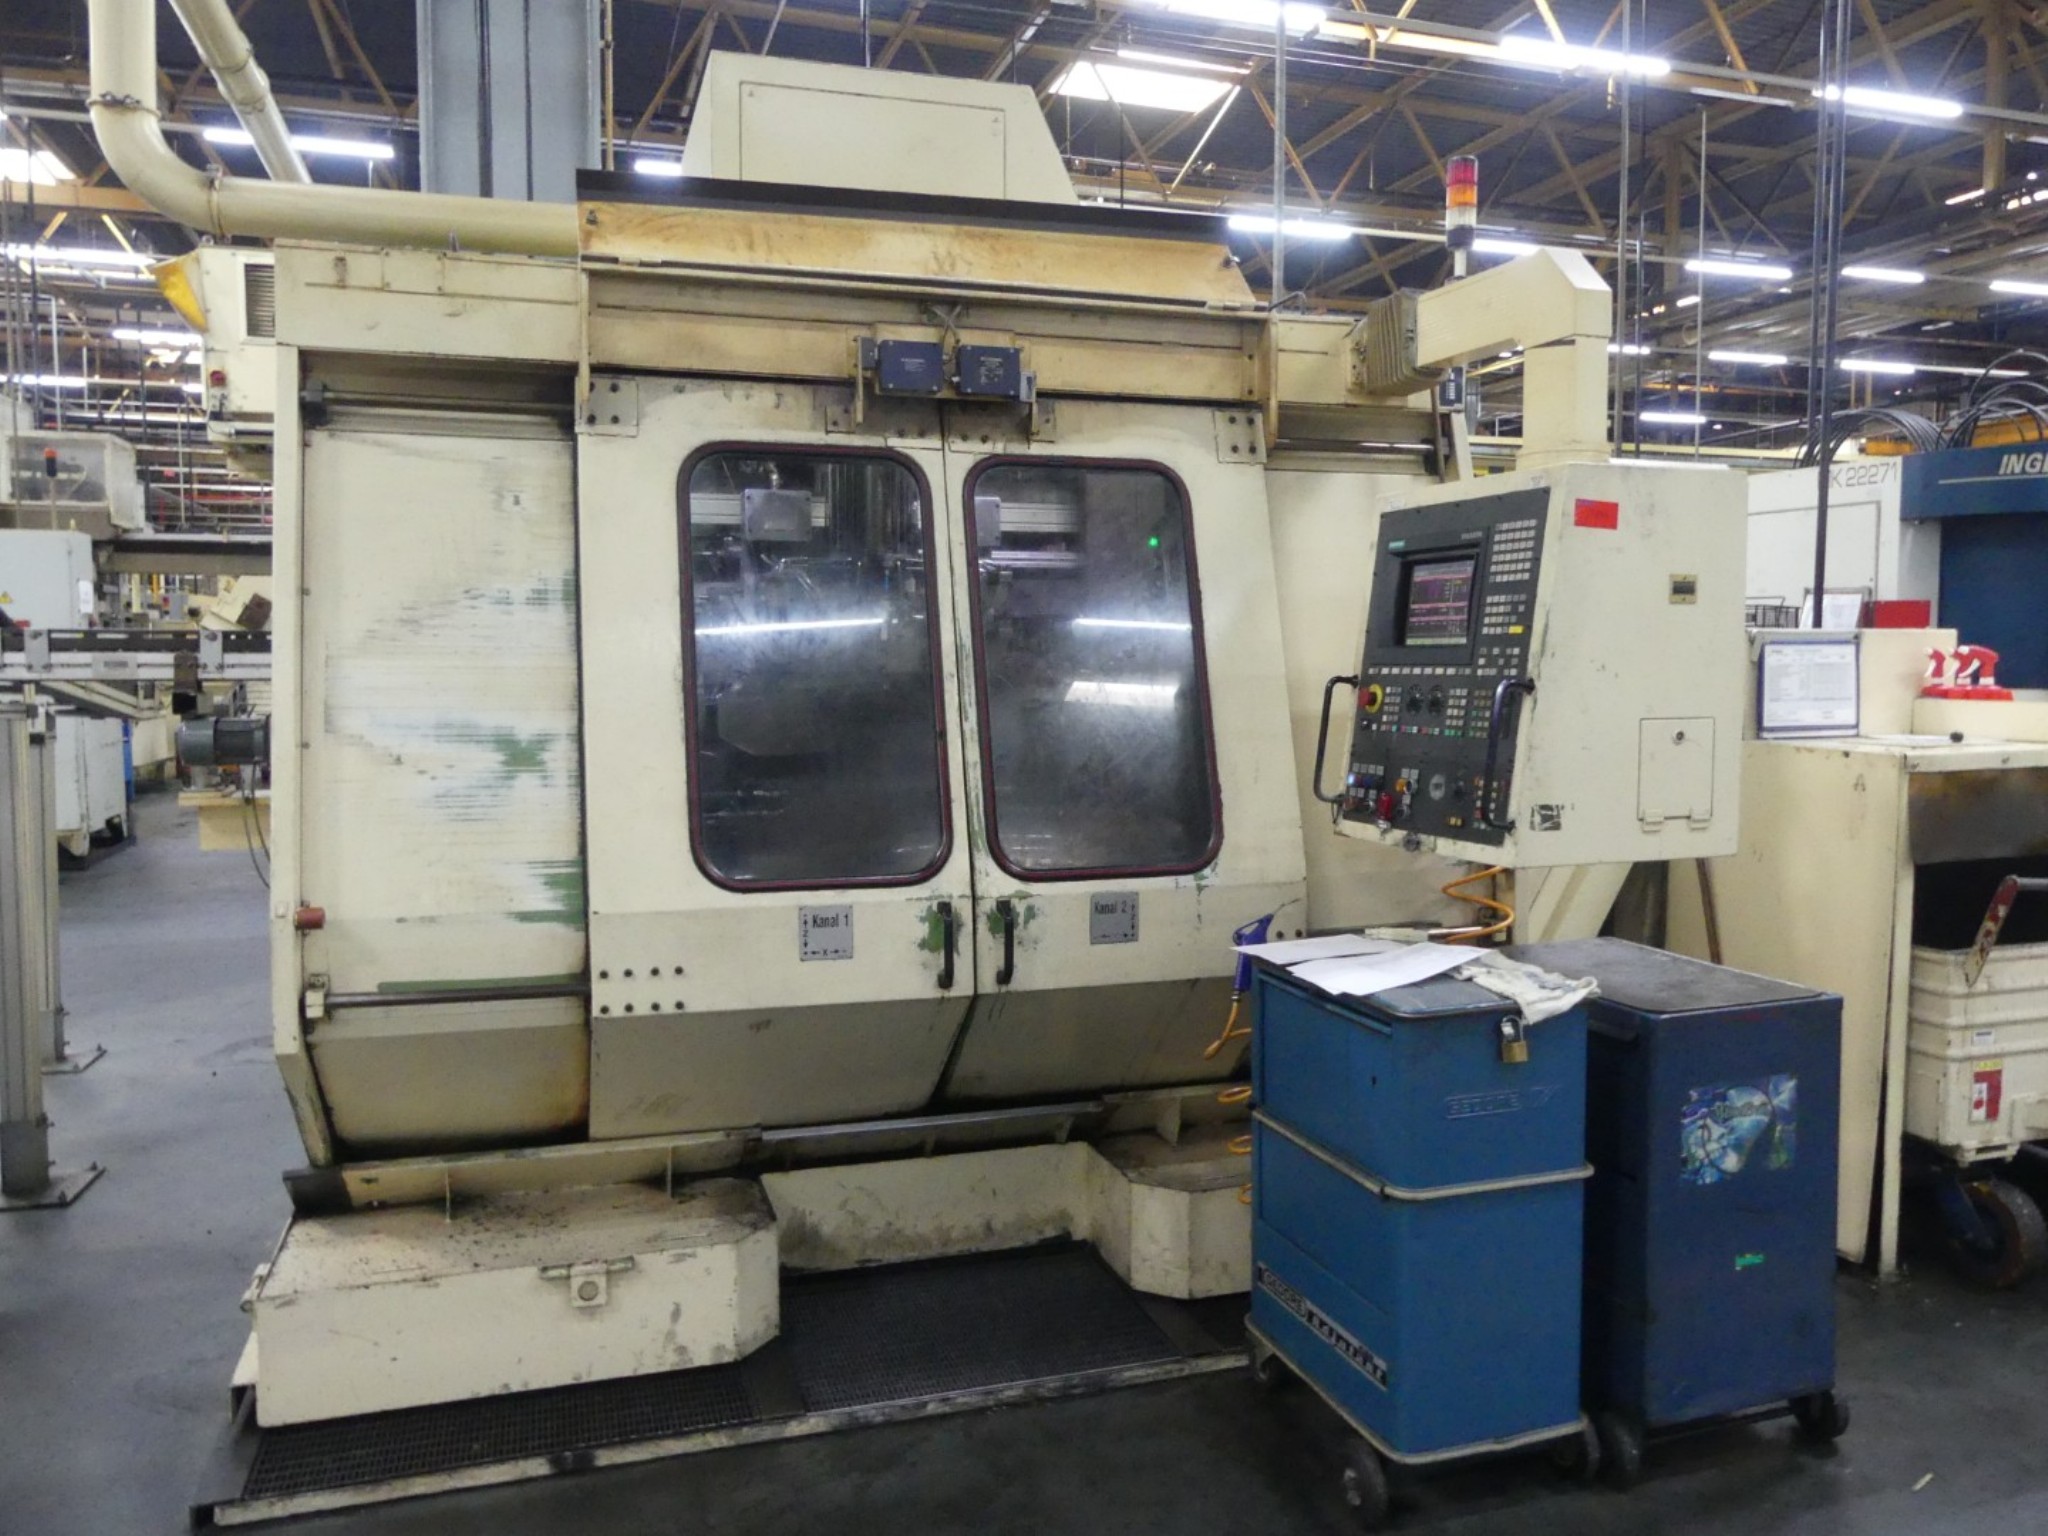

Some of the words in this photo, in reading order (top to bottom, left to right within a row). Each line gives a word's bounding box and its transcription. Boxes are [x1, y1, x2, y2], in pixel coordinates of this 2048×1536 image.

[1094, 900, 1117, 915] Kanal
[1121, 900, 1127, 914] 2
[812, 912, 840, 928] Kanal
[844, 913, 849, 927] 1
